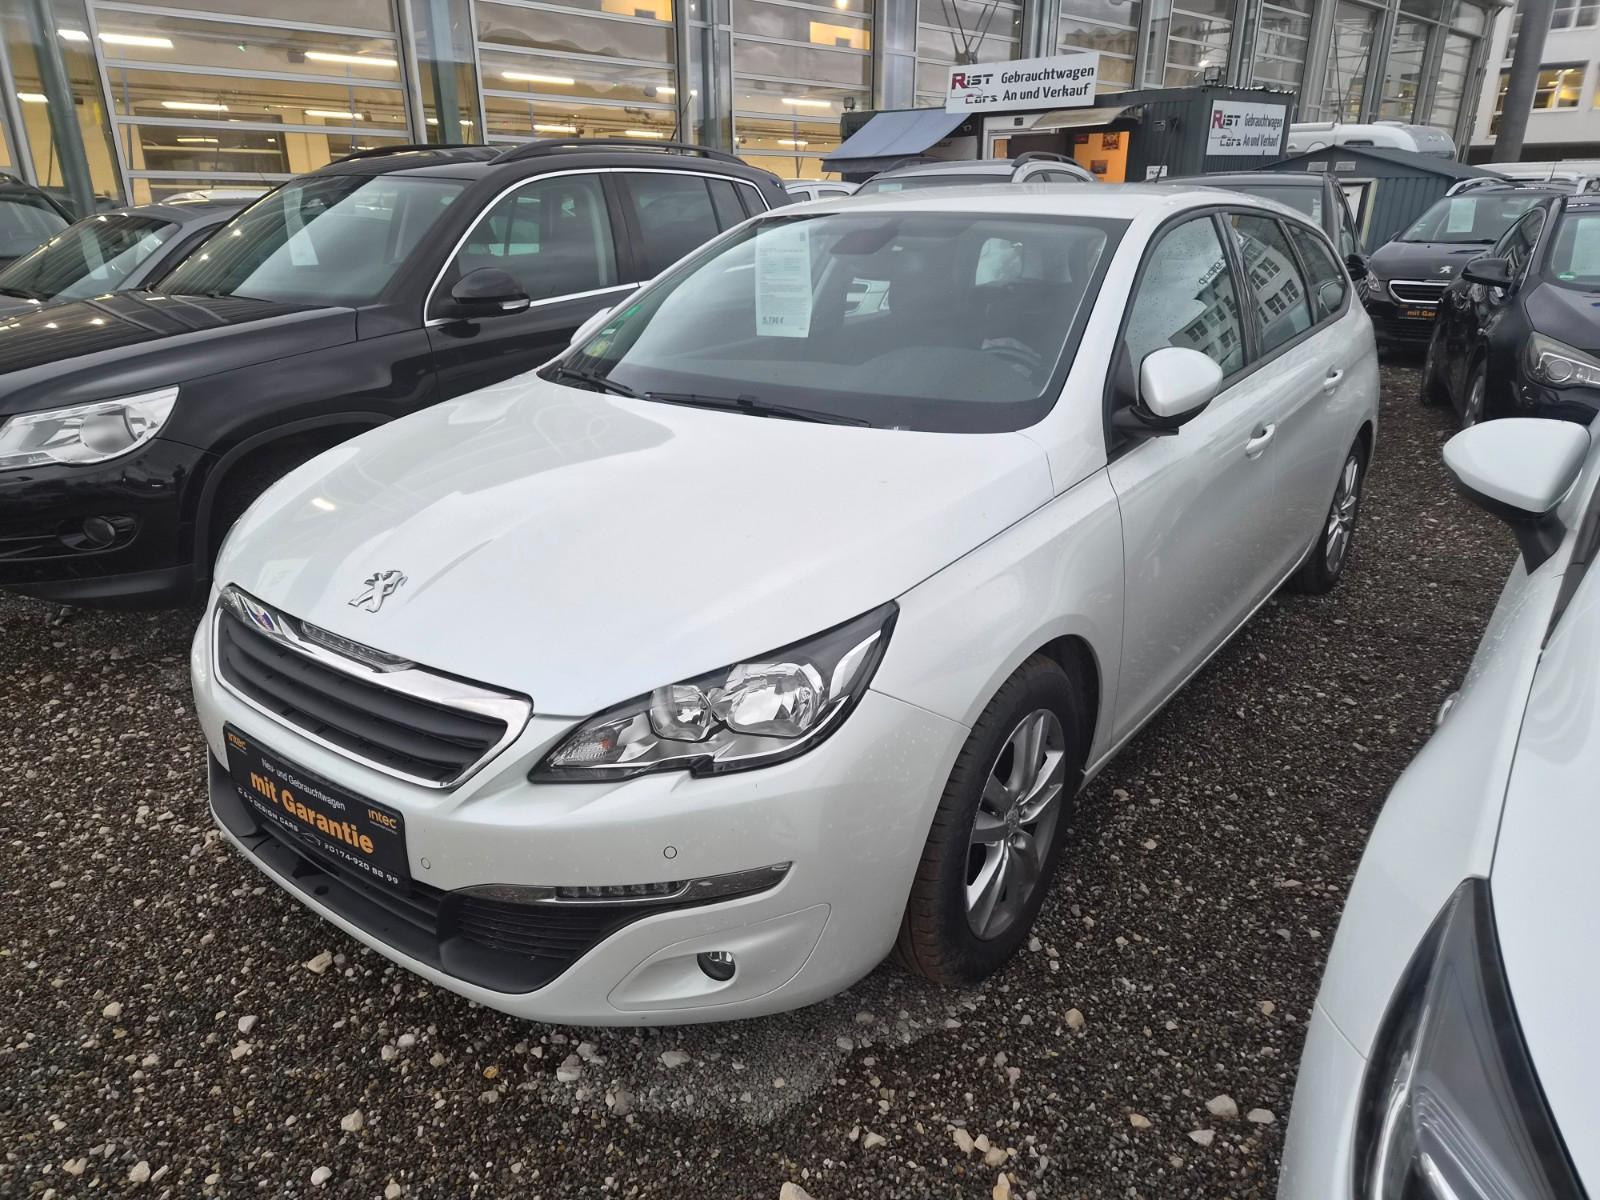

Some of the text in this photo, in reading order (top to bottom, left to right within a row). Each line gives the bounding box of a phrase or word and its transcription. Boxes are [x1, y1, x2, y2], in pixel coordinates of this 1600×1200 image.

[1001, 66, 1095, 84] Gebrauchtwagen
[965, 93, 998, 105] Cars
[1002, 82, 1091, 101] An und Verkauf
[1244, 113, 1282, 131] Gebrauchtwagen
[1242, 134, 1280, 147] An und Verkauf
[276, 769, 288, 782] und
[288, 774, 347, 812] Gebrauchtwagen
[250, 771, 375, 855] mit Garantie
[253, 799, 278, 820] DESIGN
[279, 816, 299, 832] CARS
[386, 874, 399, 885] 99
